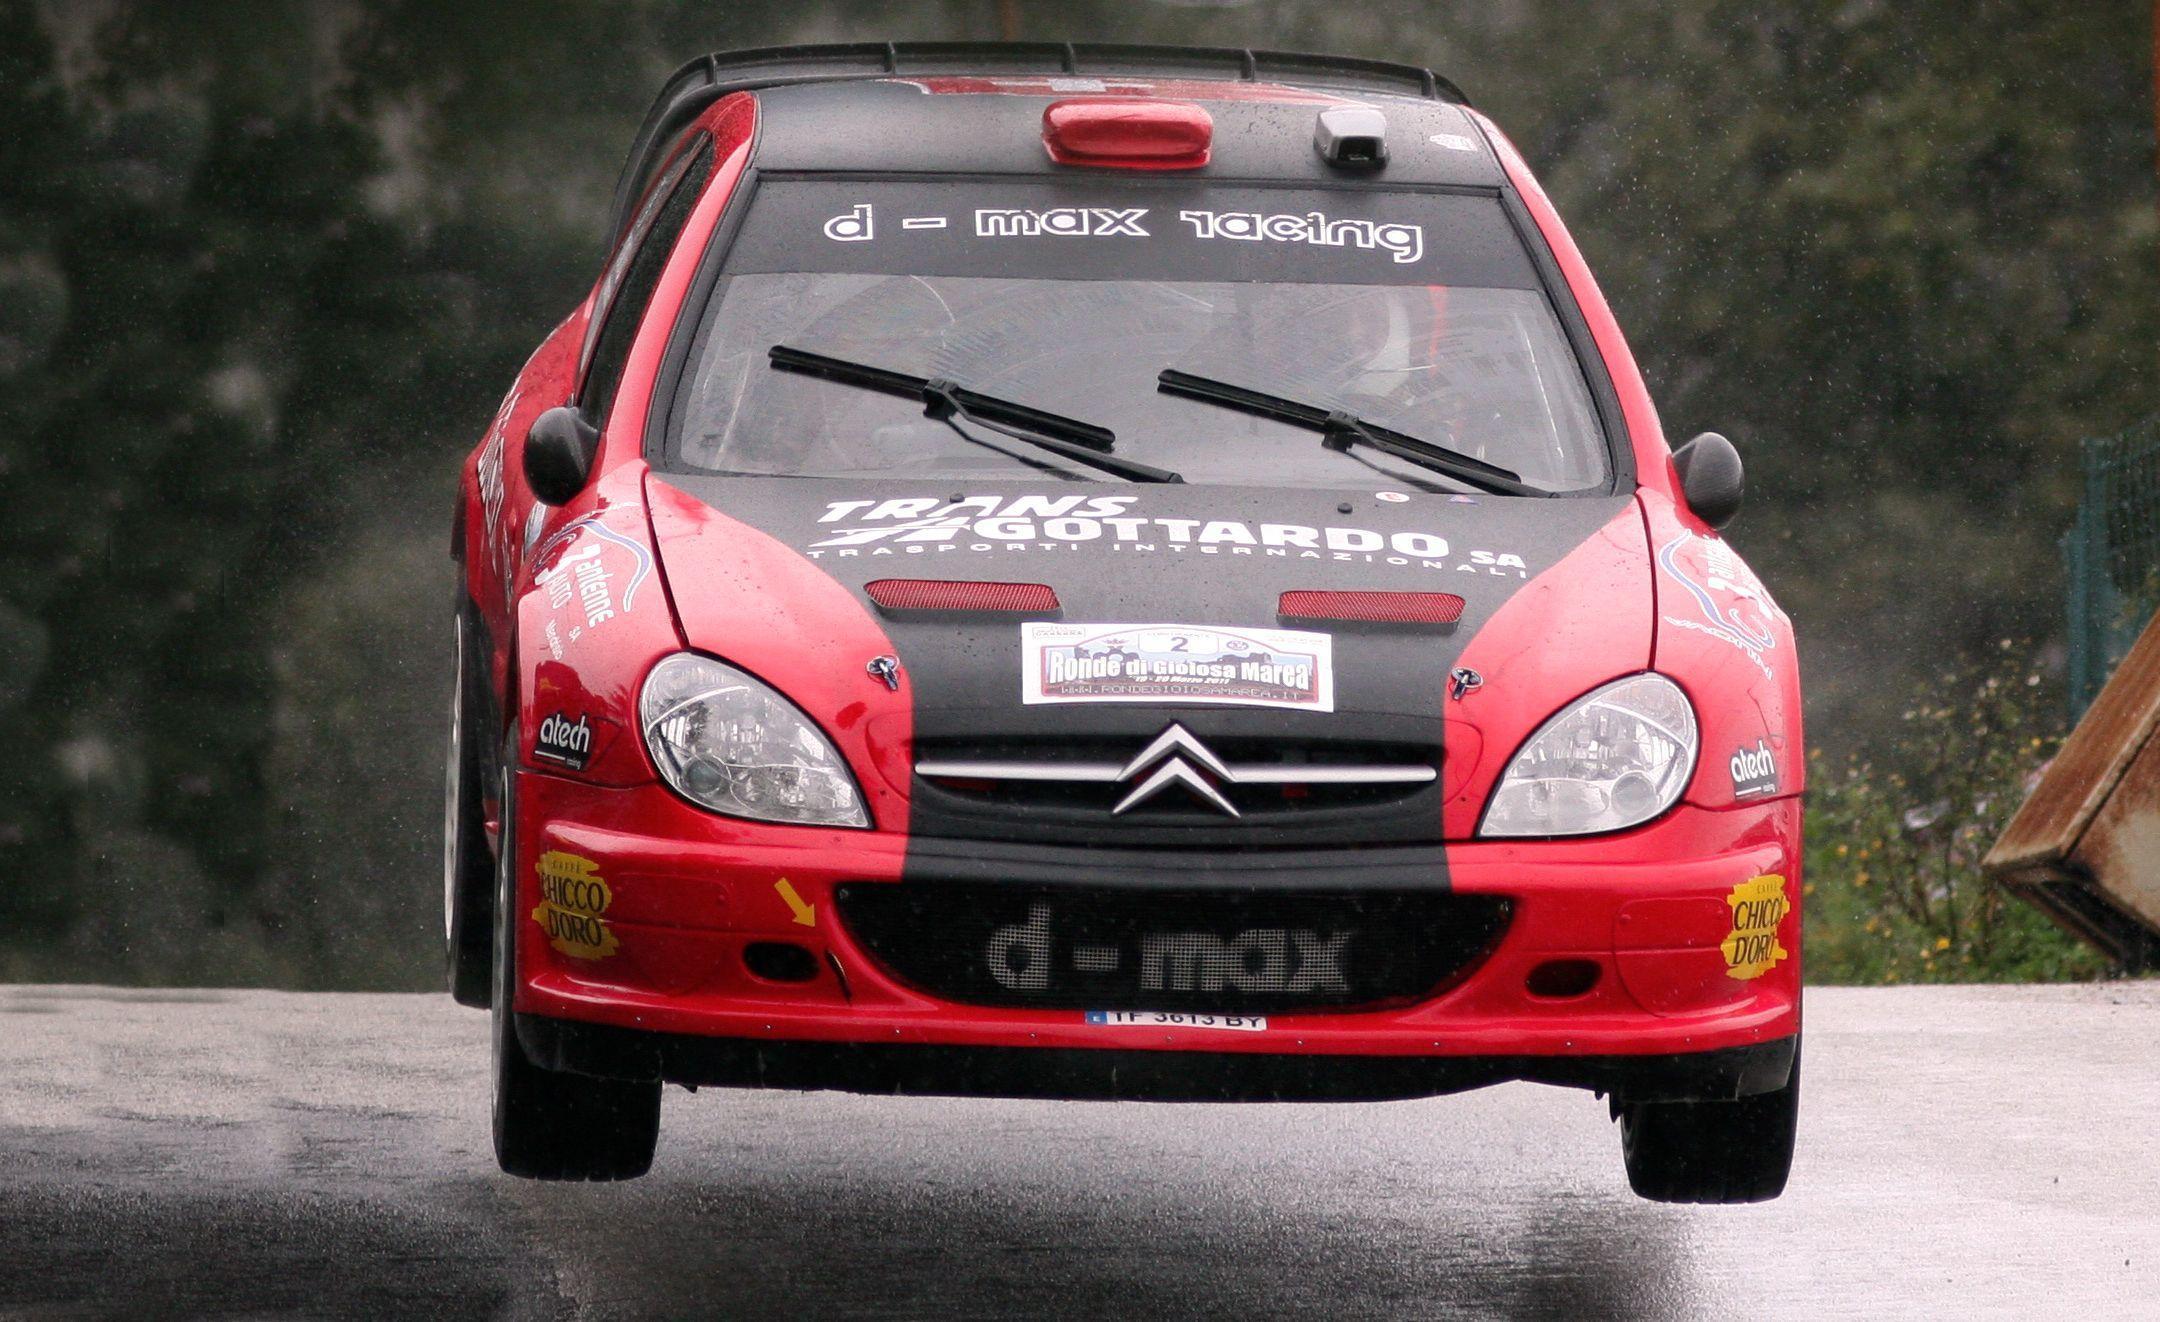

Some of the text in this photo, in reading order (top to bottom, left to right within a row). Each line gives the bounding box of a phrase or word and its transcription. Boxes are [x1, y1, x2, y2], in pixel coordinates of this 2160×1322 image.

[975, 208, 1151, 238] max
[817, 496, 1139, 523] TRANS
[807, 543, 1527, 579] TRASPORTI INTERNAZIONALI
[973, 517, 1527, 569] GOTTARDO SA
[1170, 636, 1189, 652] 2
[1050, 652, 1310, 690] Ronde di Gioiosa Marea
[540, 713, 590, 753] atech
[1731, 740, 1775, 782] atech
[1140, 928, 1351, 992] max
